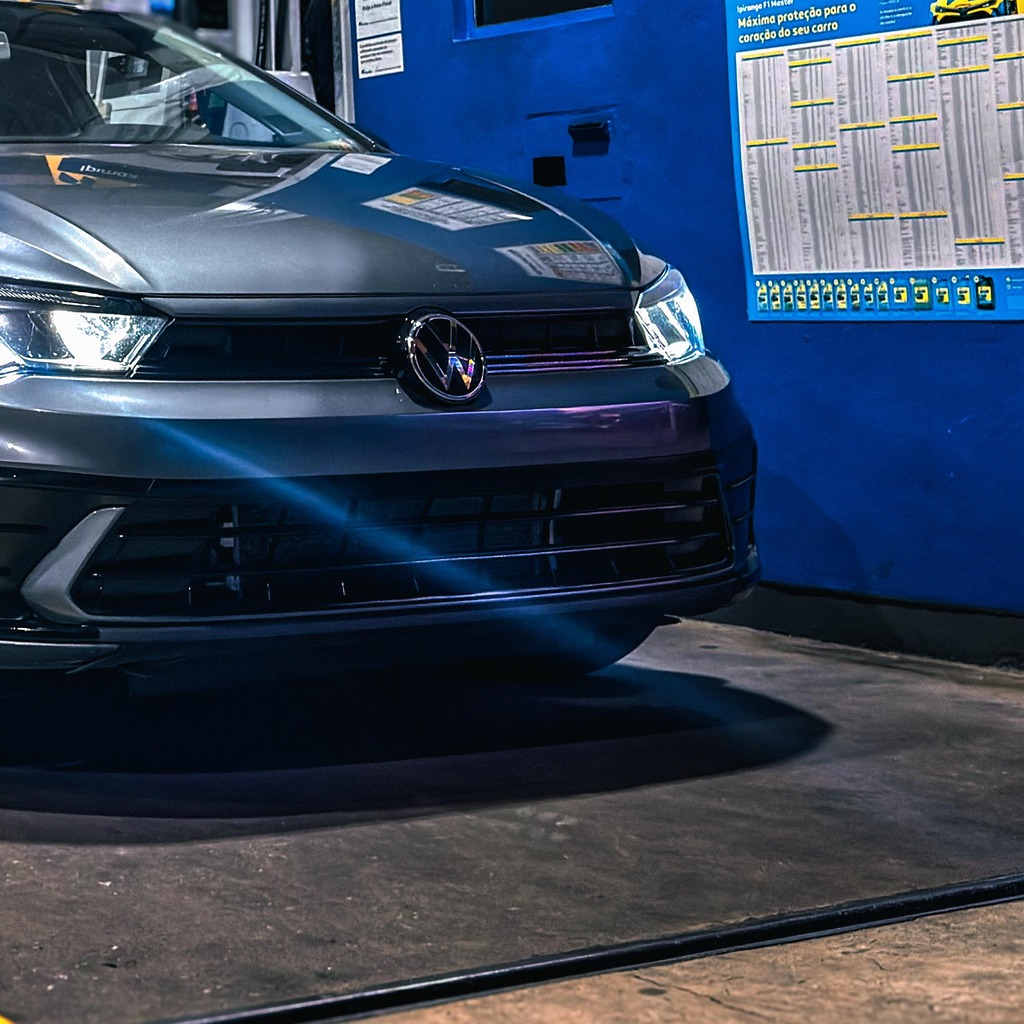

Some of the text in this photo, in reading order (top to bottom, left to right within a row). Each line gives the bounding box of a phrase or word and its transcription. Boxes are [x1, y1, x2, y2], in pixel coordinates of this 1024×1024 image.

[736, 3, 763, 14] Ipiranga
[737, 3, 857, 29] Máxima proteção para o
[738, 21, 839, 44] coração do seu carro
